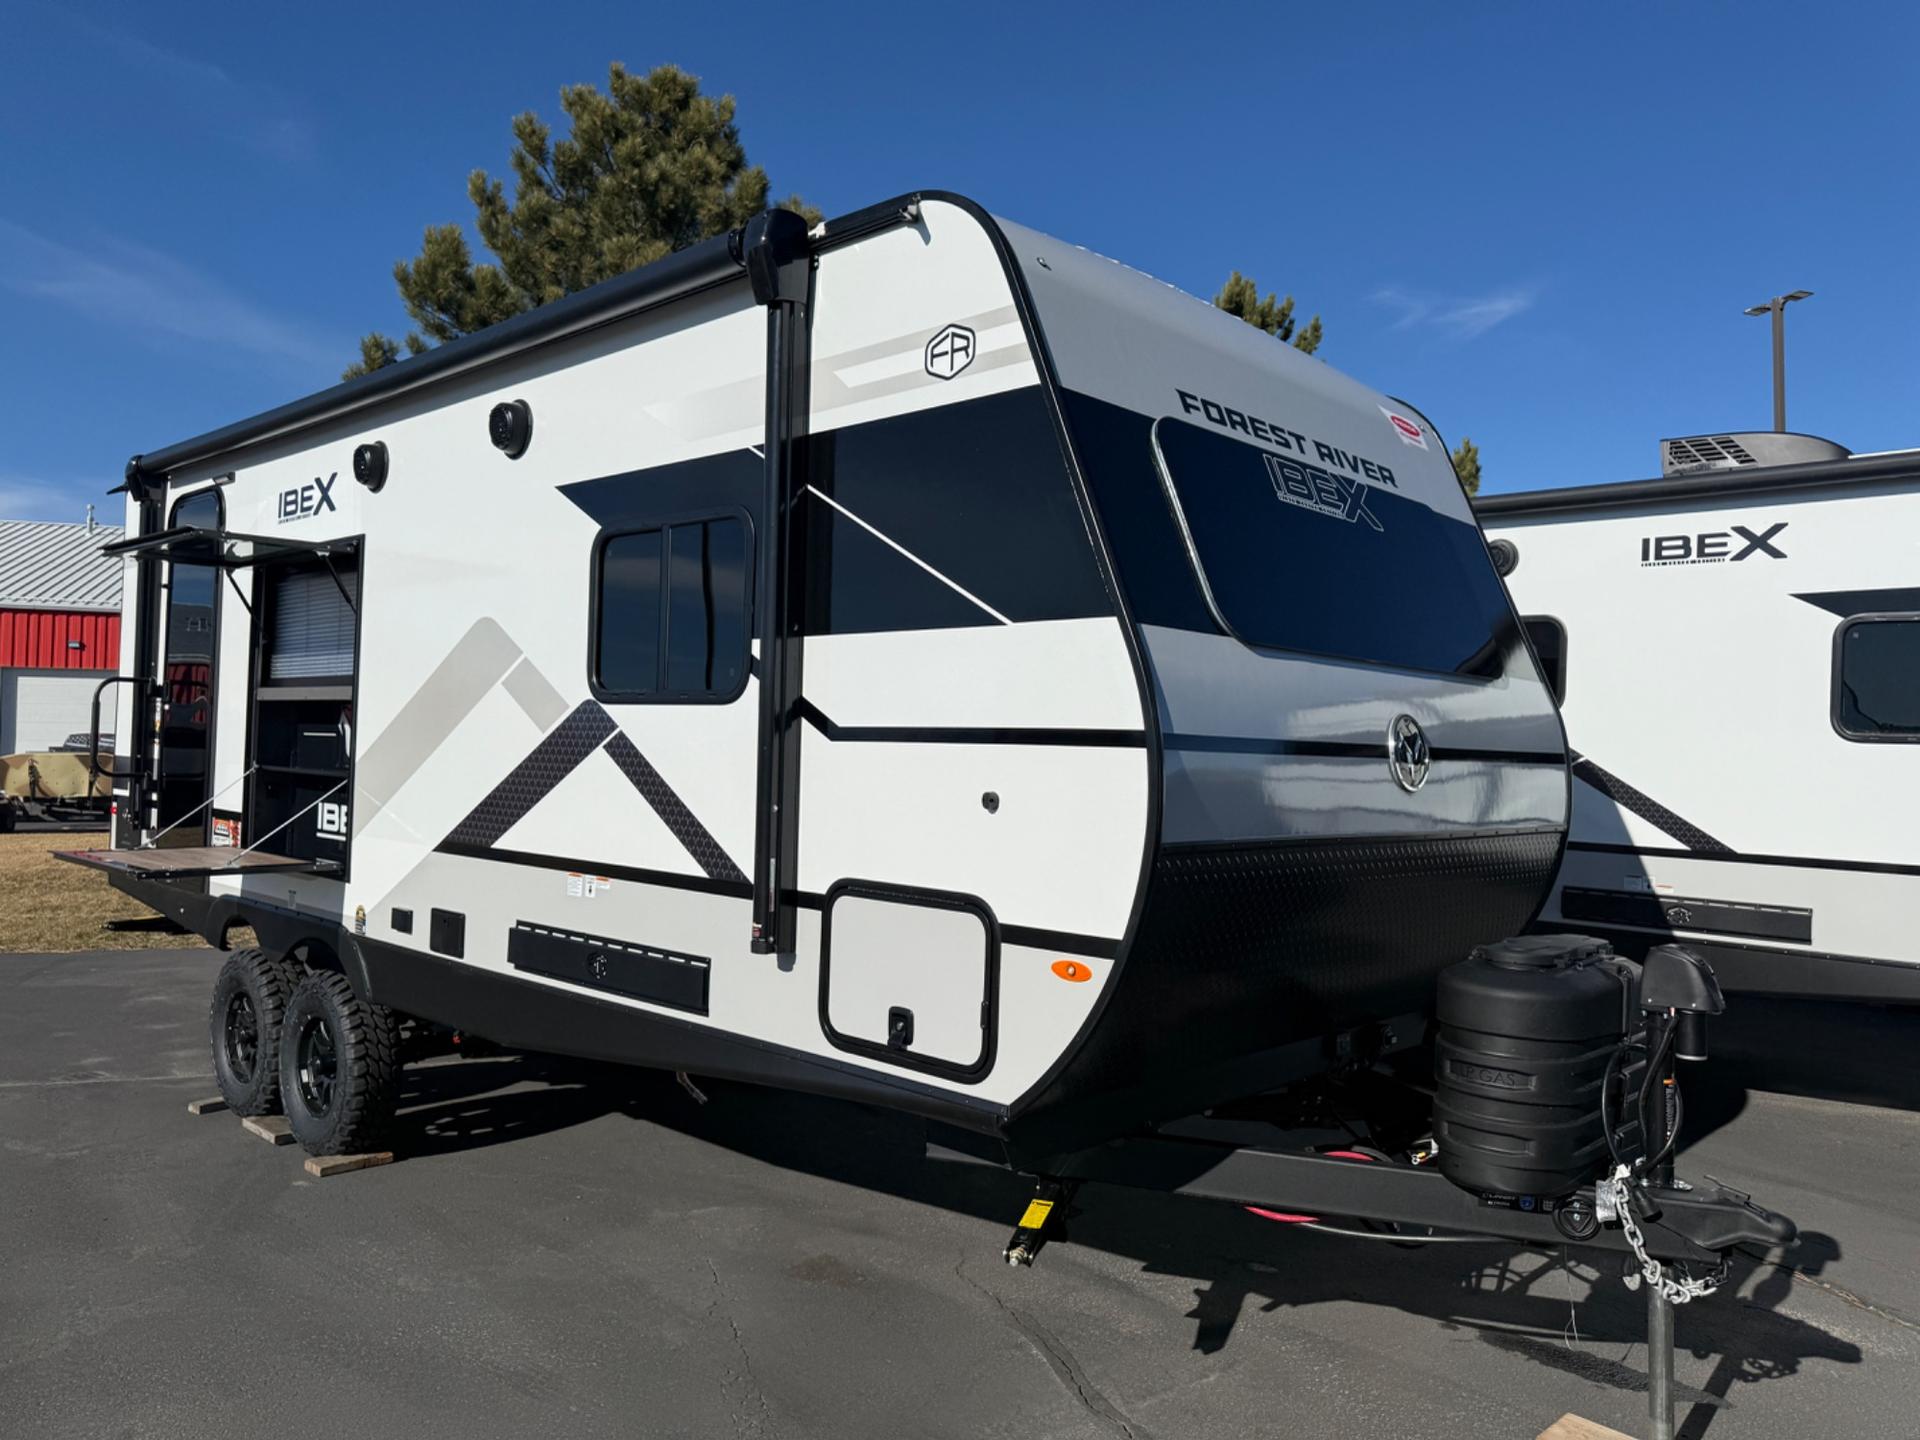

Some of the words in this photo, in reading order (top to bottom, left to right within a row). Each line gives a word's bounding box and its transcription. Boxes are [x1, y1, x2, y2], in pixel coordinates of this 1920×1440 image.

[1175, 388, 1306, 455] FOREST
[1311, 440, 1398, 488] RIVER
[278, 472, 338, 519] IBEX
[1262, 453, 1384, 532] IBEX
[1641, 522, 1789, 562] IBEX
